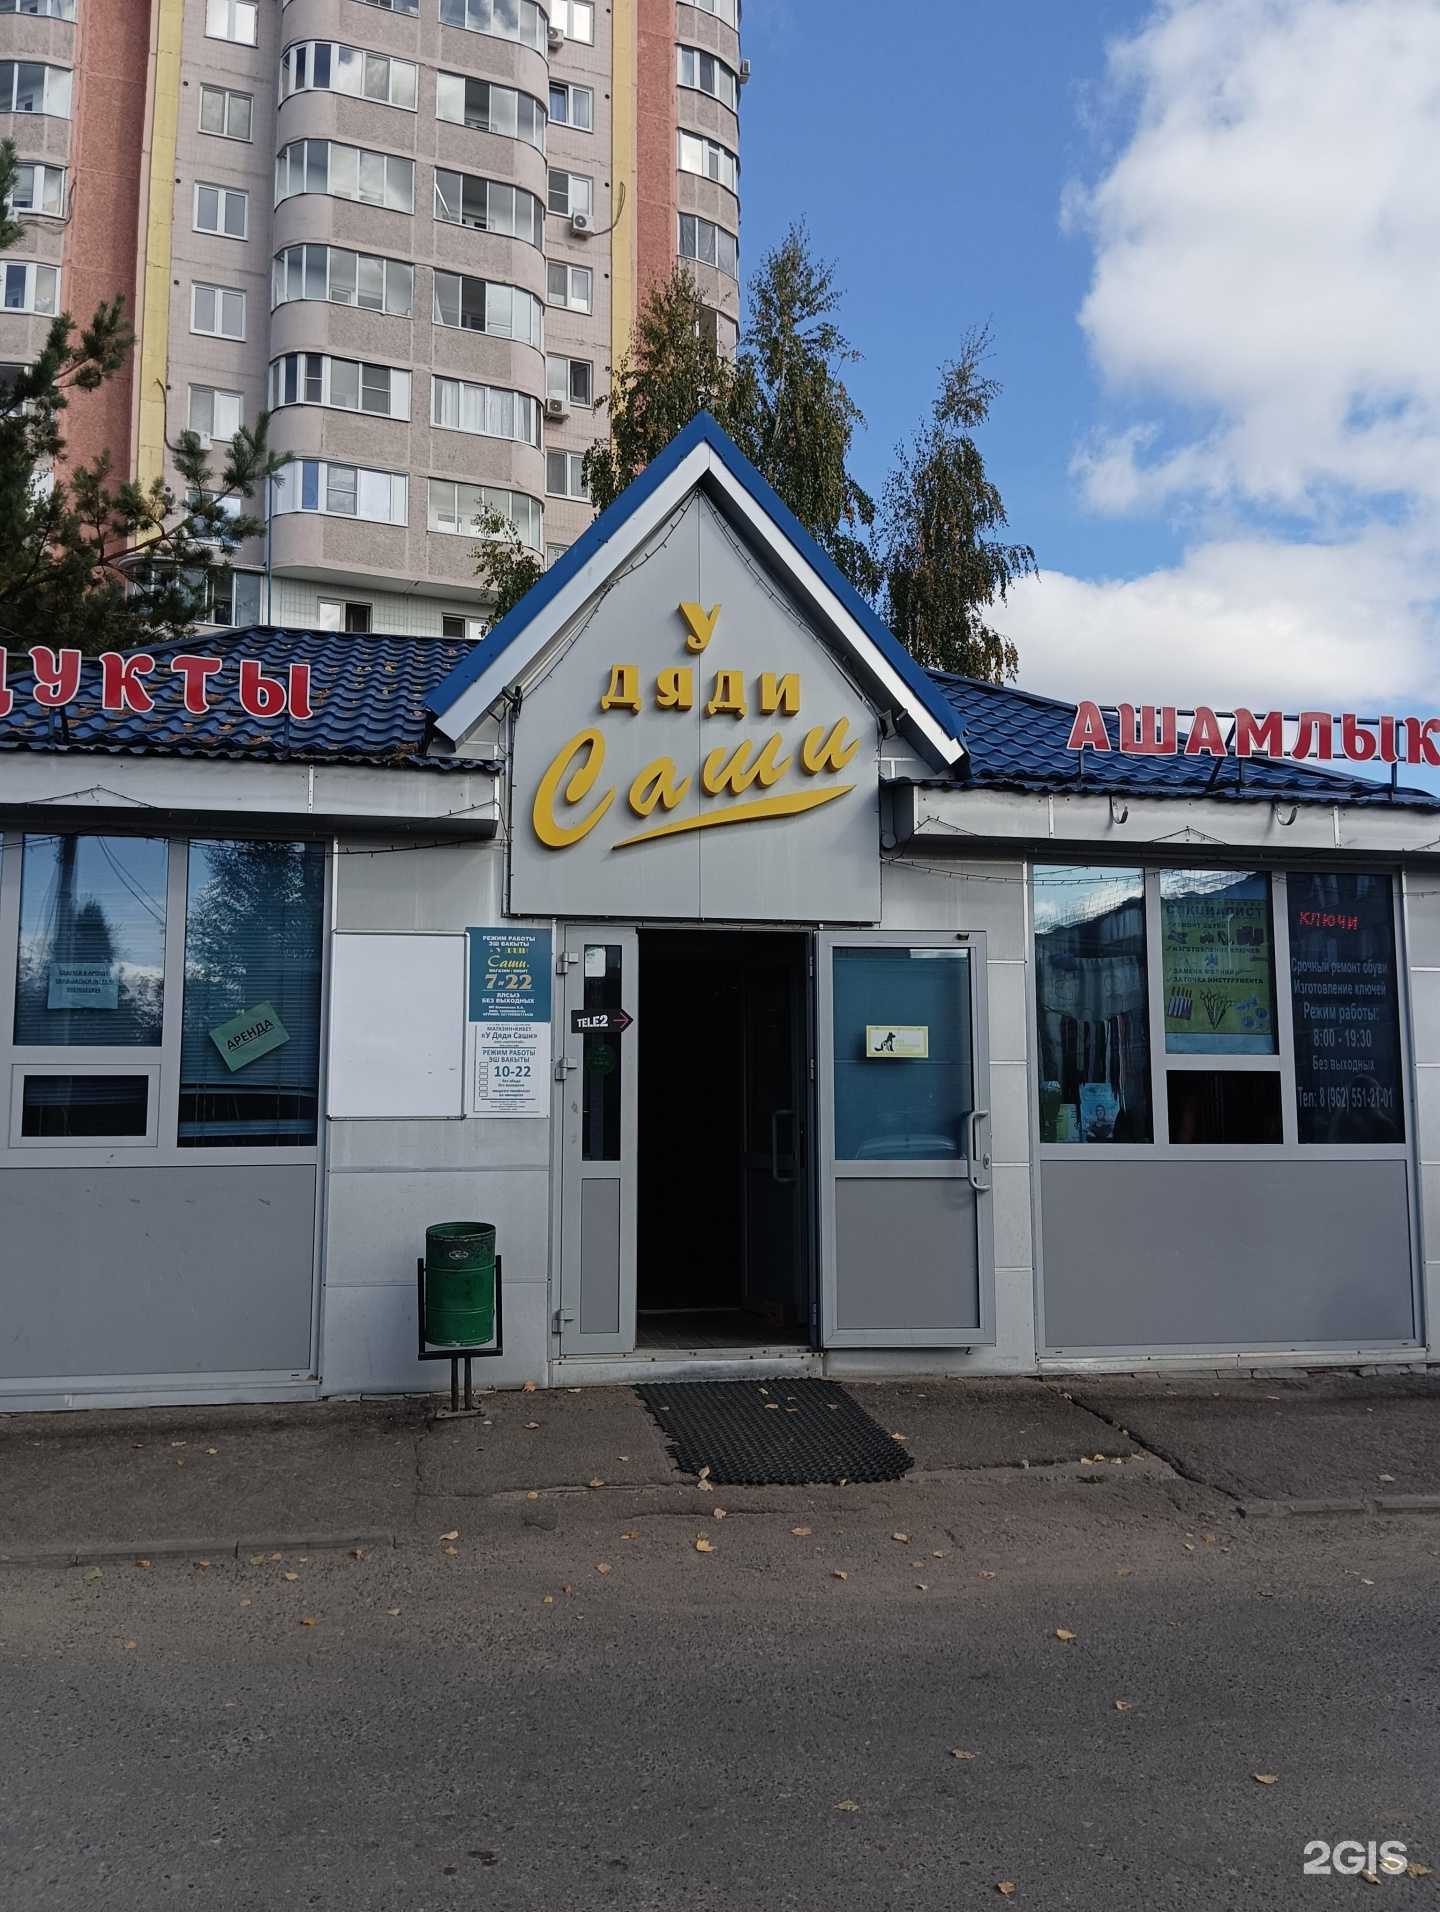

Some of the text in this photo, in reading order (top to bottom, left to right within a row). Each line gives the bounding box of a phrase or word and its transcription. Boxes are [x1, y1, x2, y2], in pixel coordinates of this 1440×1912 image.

[677, 601, 721, 653] У
[601, 664, 800, 719] ДЯДИ
[1067, 701, 1440, 767] АШАМЛЫК
[532, 716, 861, 849] Саши
[577, 1014, 609, 1028] TELE2
[1303, 1002, 1336, 1019] Режим
[226, 1019, 273, 1050] АРЕНДА
[1313, 1029, 1335, 1048] 8:00
[1345, 1029, 1372, 1048] 19:30
[494, 1066, 532, 1078] 10-22
